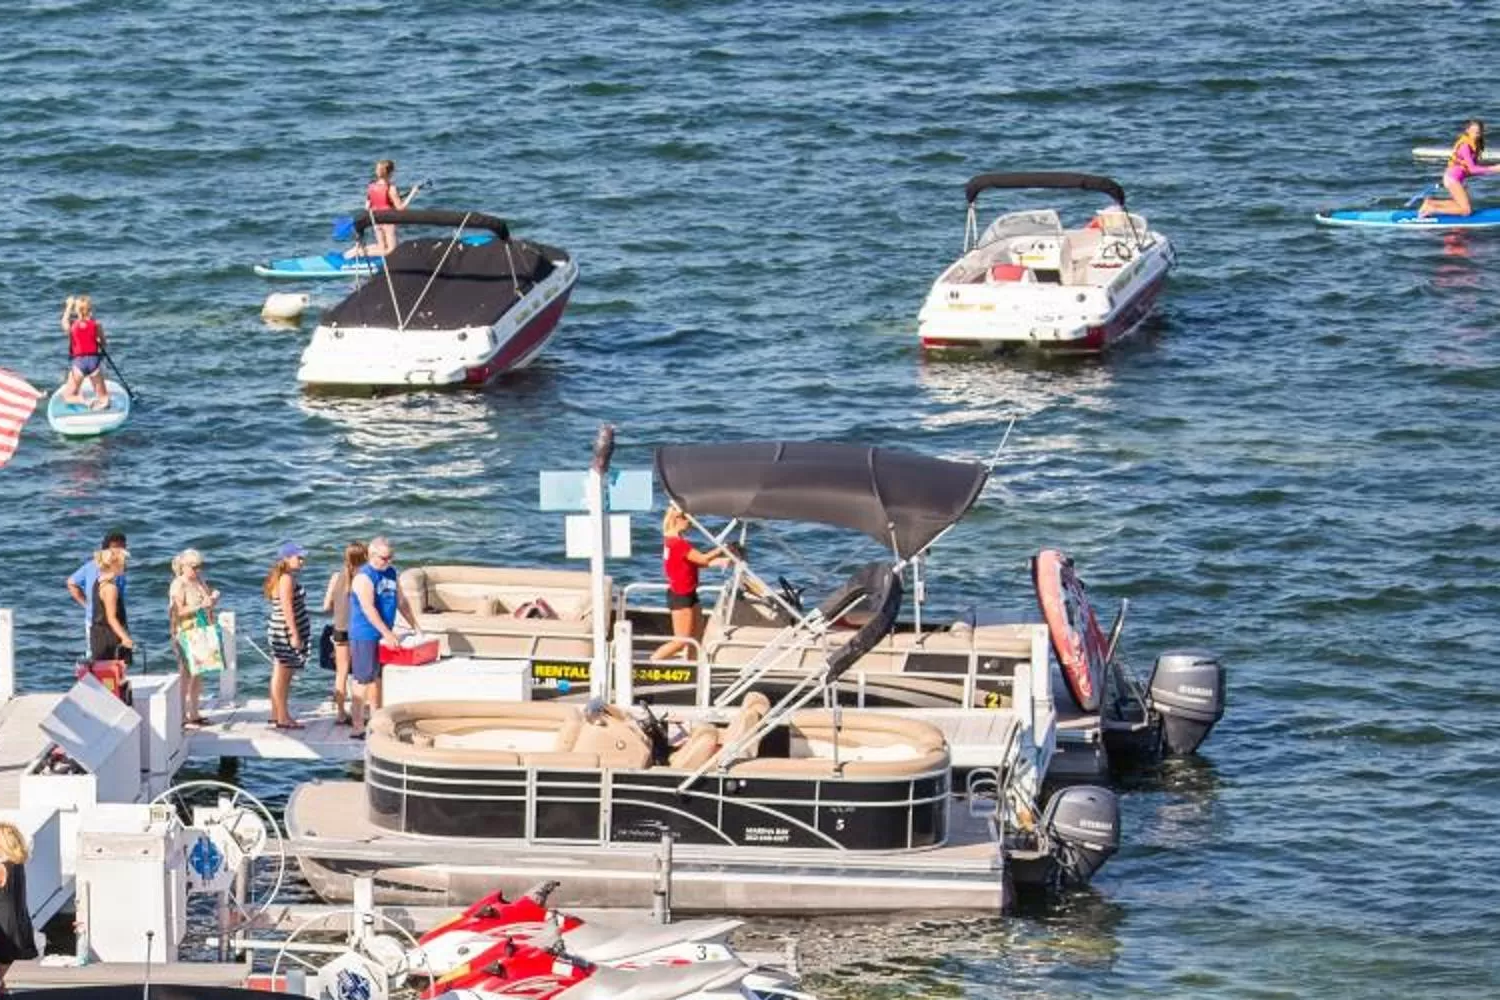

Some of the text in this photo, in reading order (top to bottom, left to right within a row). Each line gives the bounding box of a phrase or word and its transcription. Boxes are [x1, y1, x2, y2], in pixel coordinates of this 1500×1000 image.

[534, 664, 691, 681] RENTAL -248-4477
[987, 692, 997, 708] 2
[836, 819, 845, 831] 5
[696, 945, 707, 961] 3
